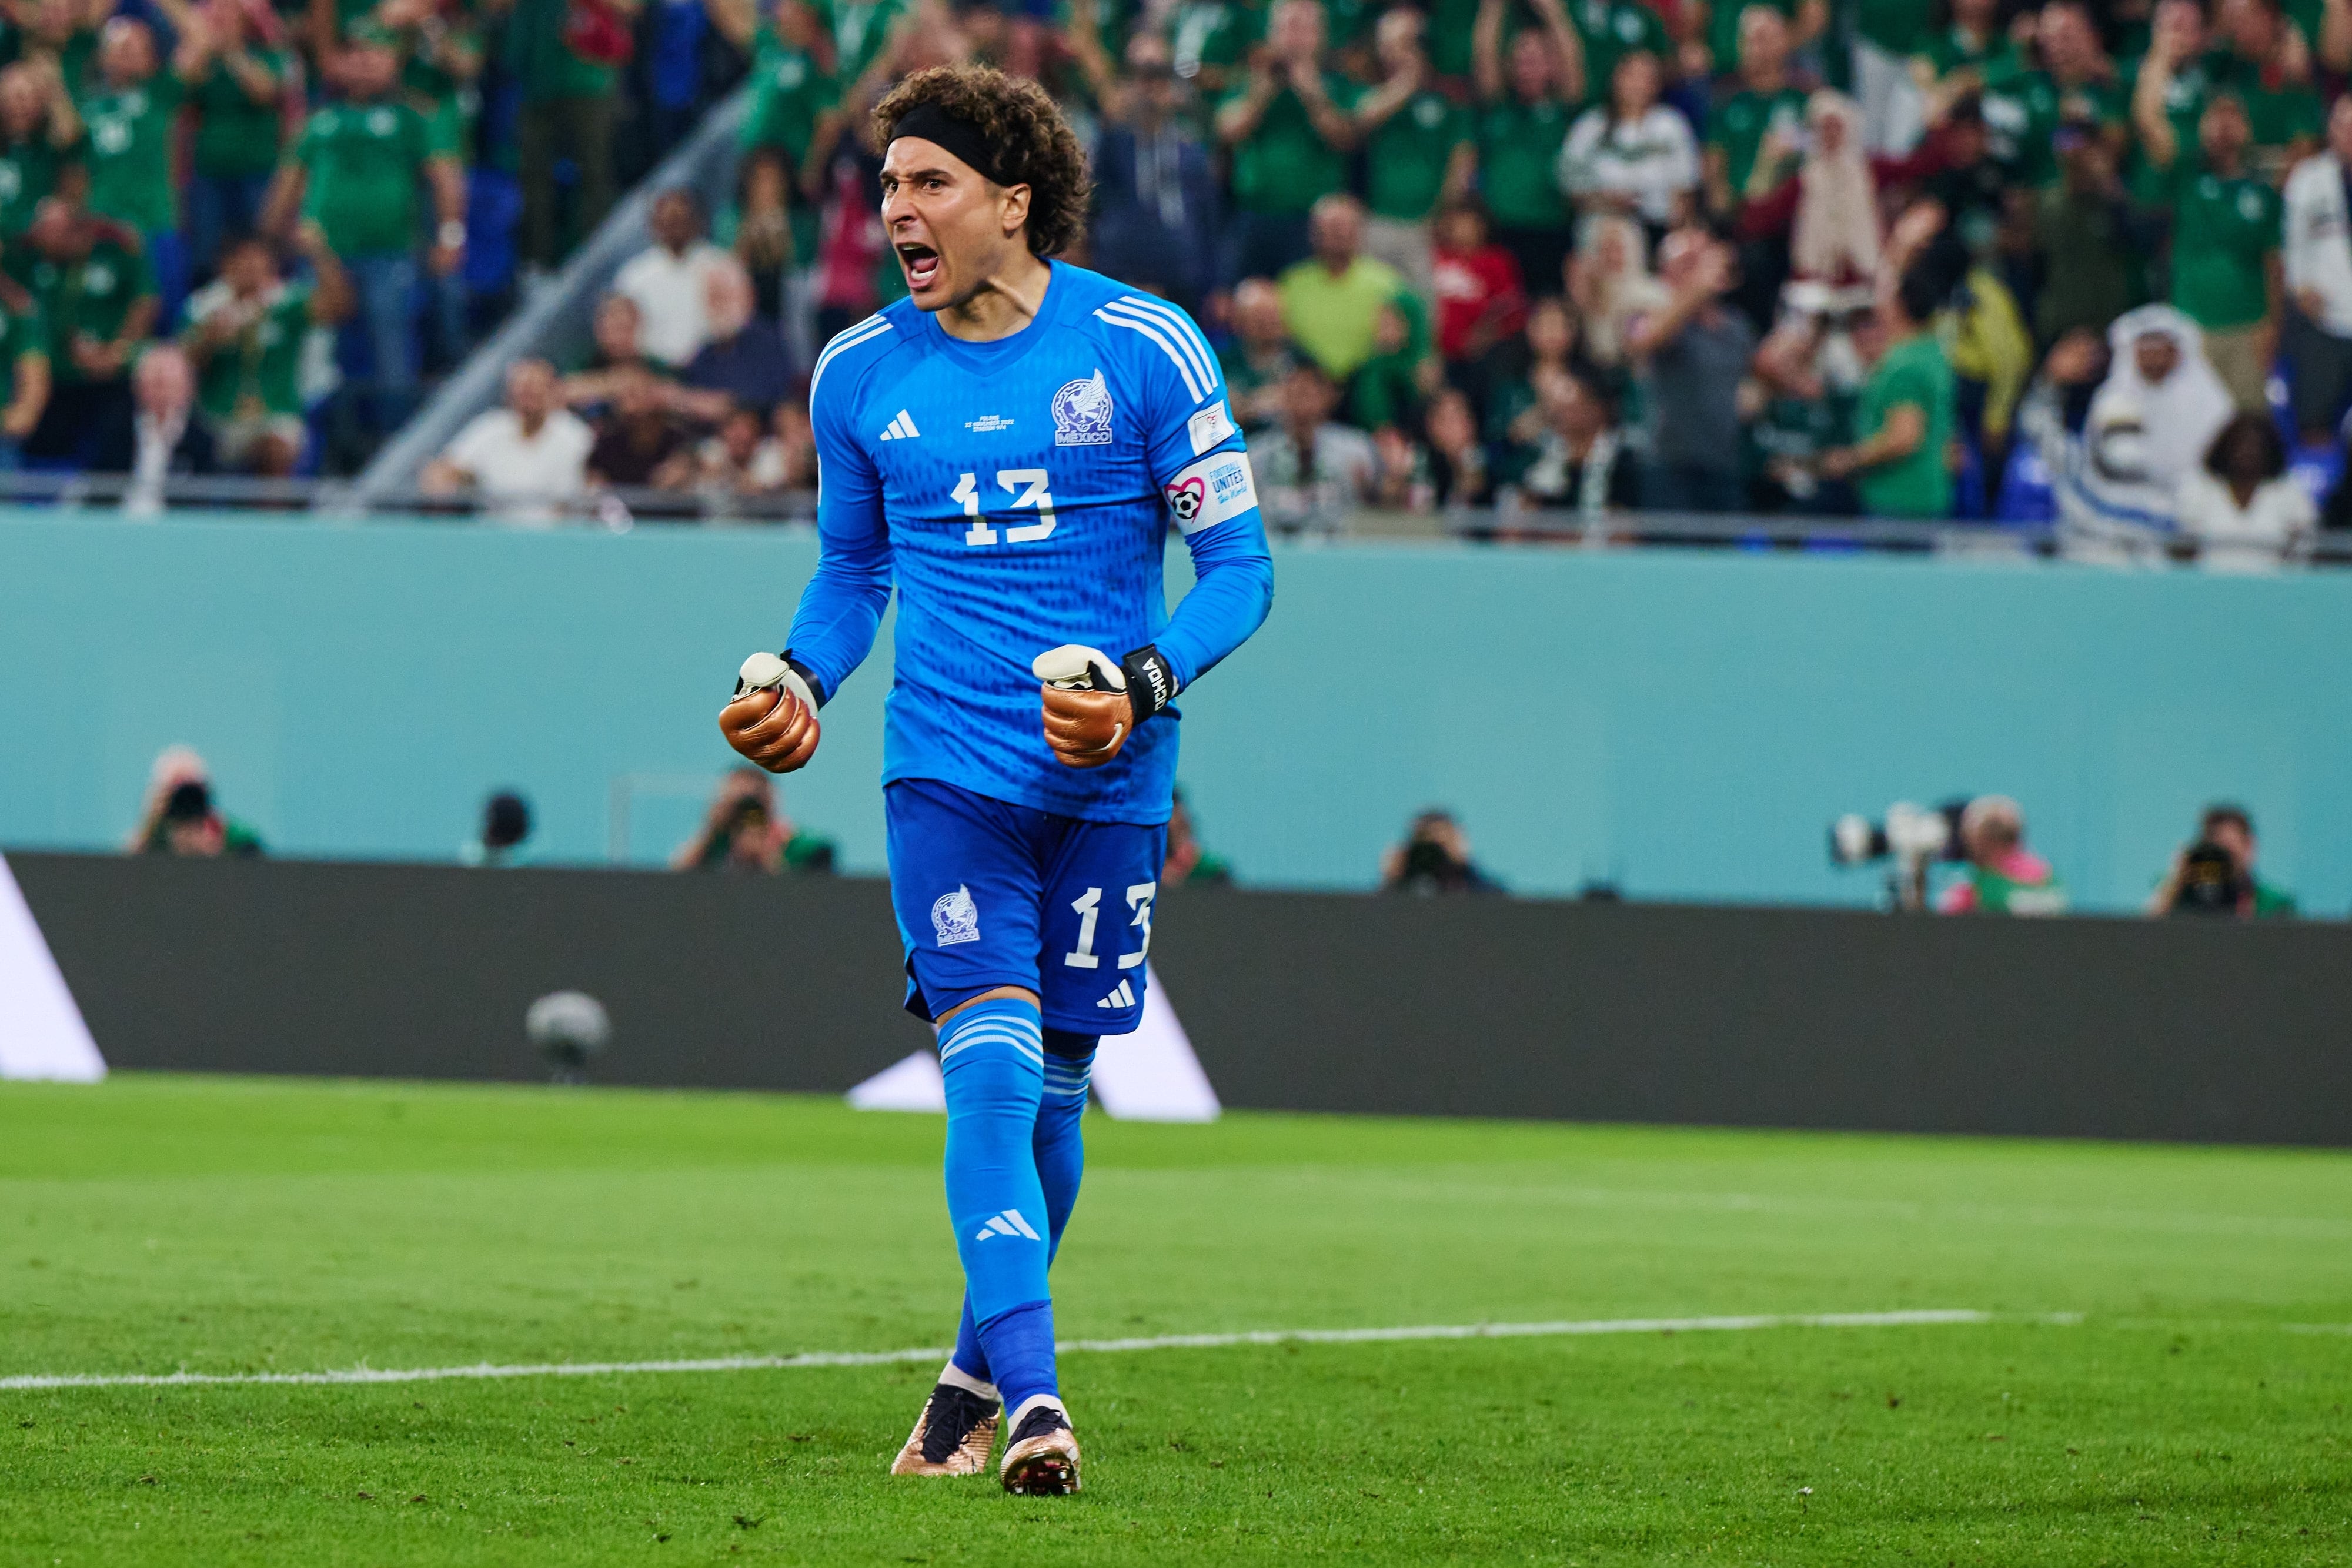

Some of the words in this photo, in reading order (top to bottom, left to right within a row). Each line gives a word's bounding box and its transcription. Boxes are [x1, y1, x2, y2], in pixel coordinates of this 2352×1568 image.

[1058, 430, 1110, 443] MÉXICO
[1210, 460, 1240, 479] FOOTBALL
[1212, 469, 1244, 493] UNITES
[950, 469, 1057, 546] 13
[1142, 657, 1167, 711] OCHOA
[1064, 881, 1156, 969] 13
